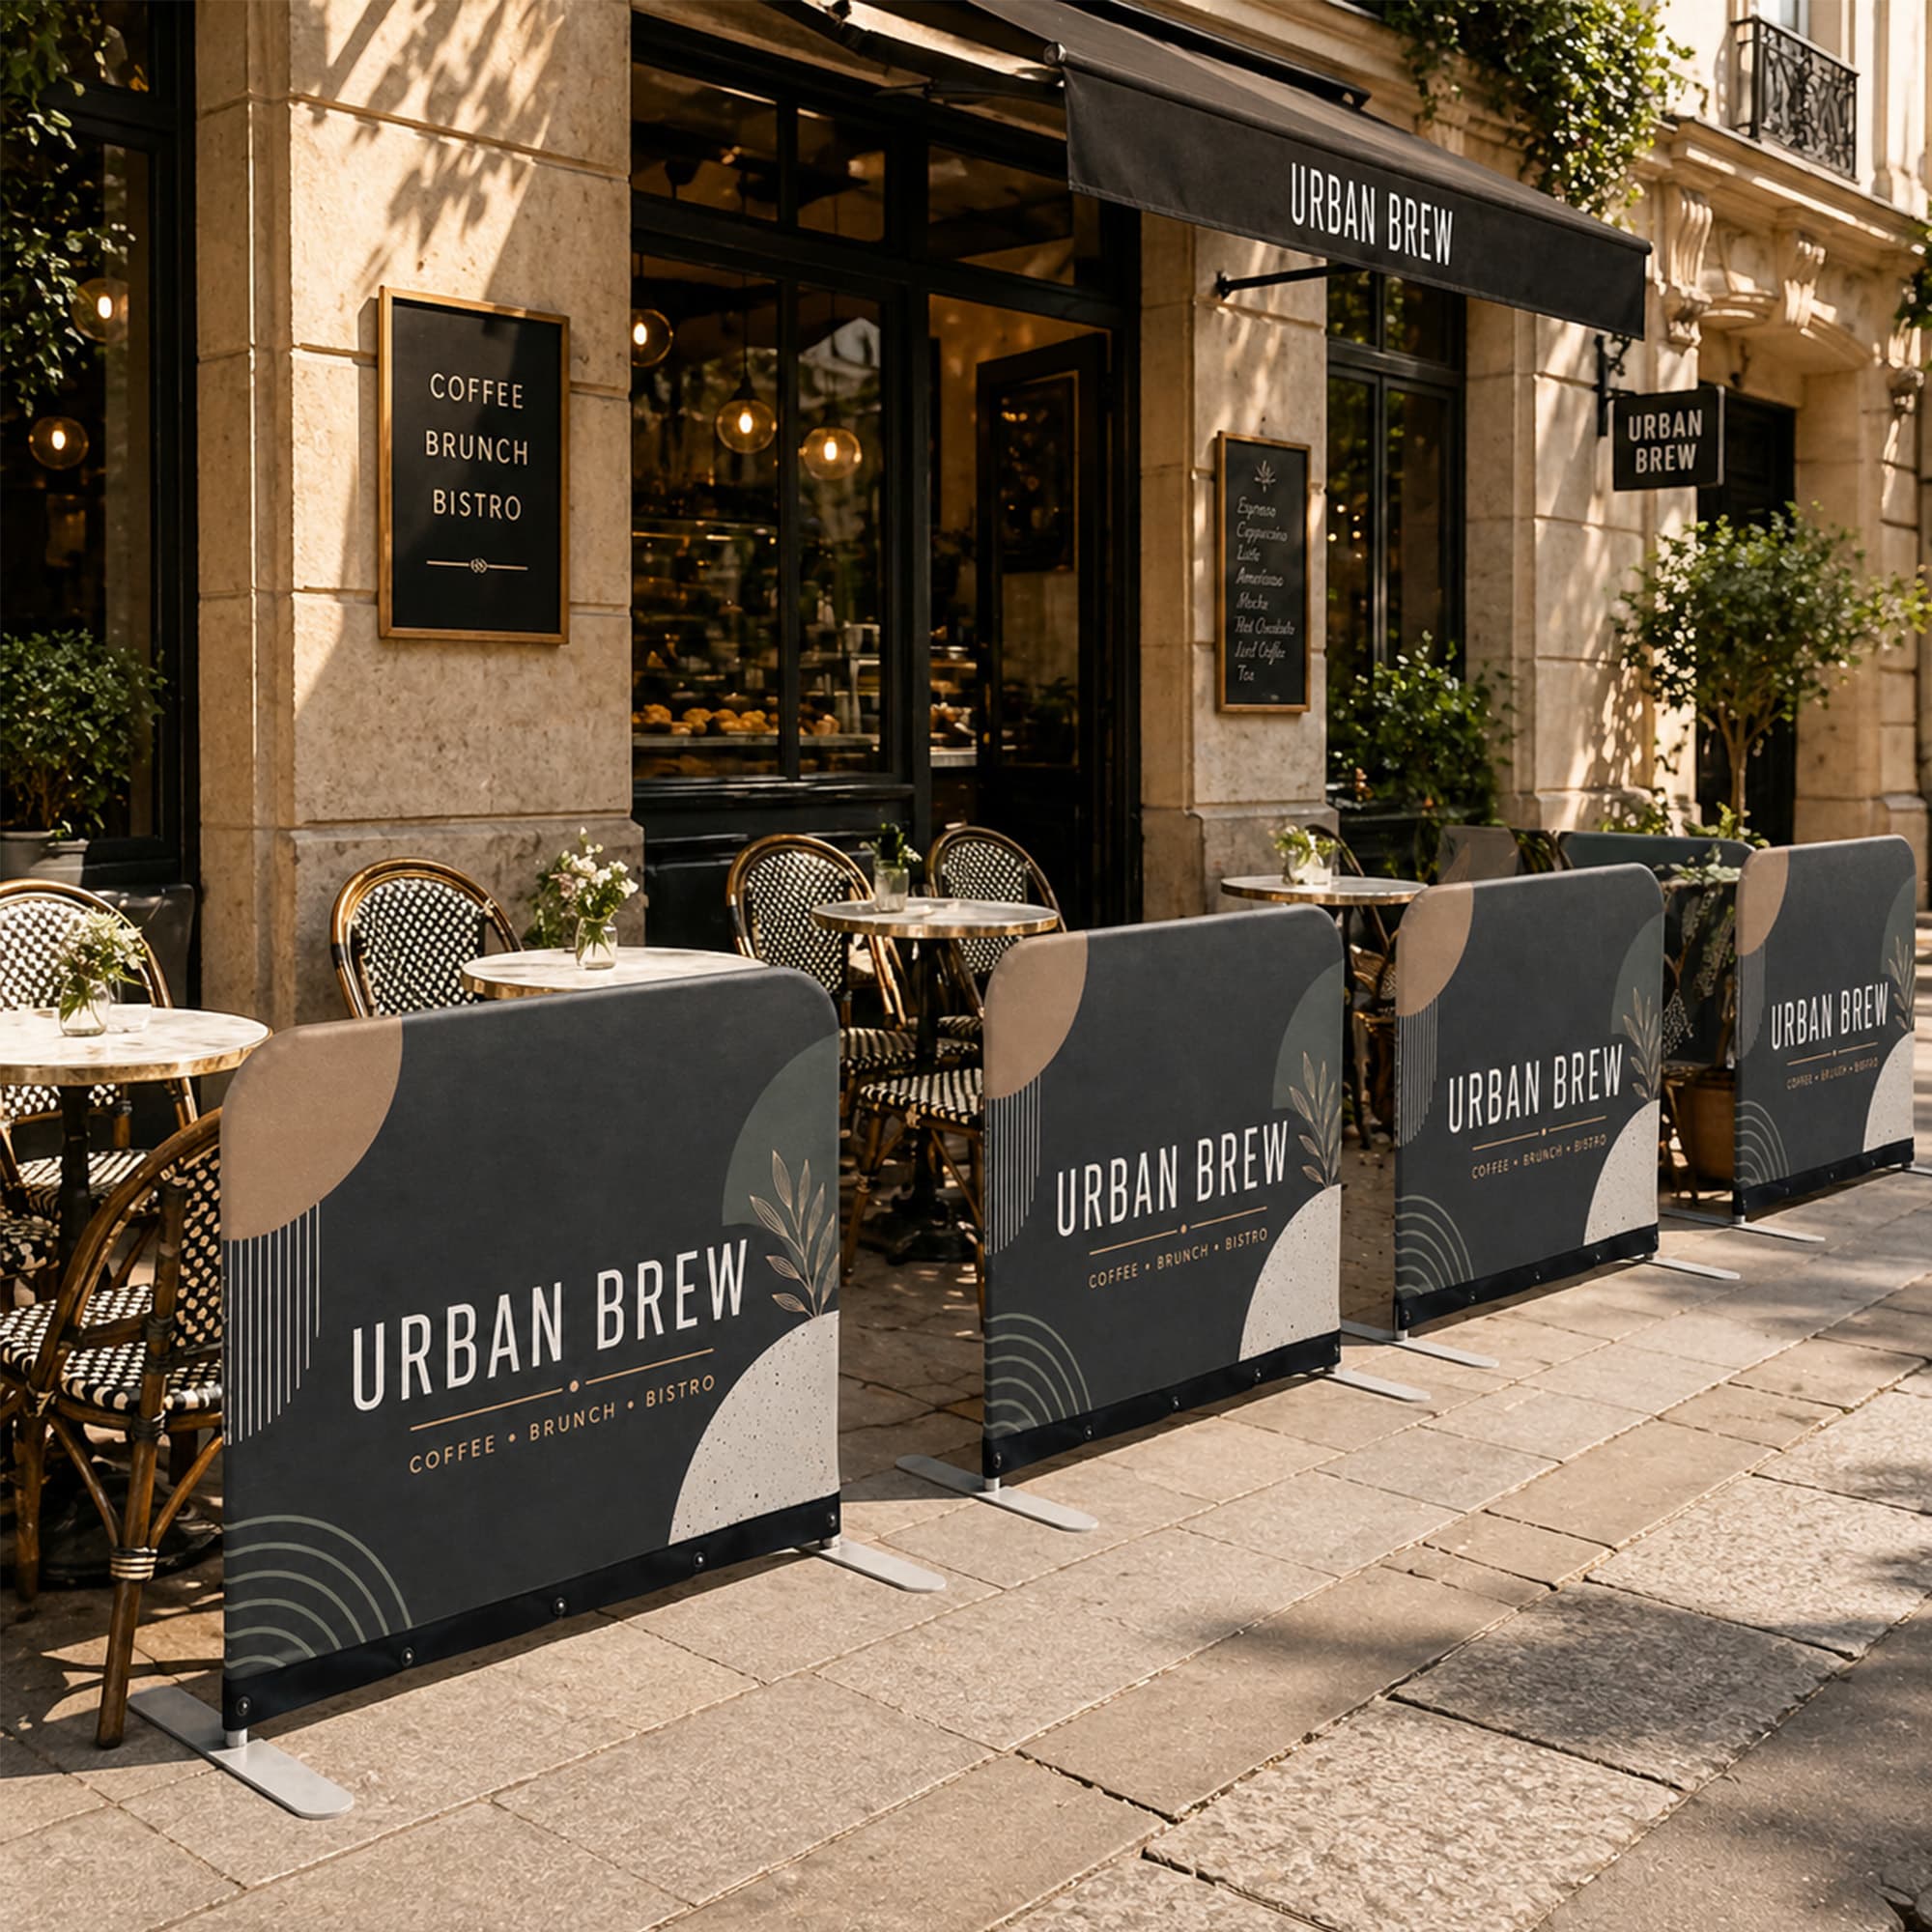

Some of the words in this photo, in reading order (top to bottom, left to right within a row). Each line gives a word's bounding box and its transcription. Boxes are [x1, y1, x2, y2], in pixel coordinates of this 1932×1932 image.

[1292, 162, 1376, 245] URBAN
[1388, 192, 1453, 266] BREW
[430, 373, 524, 410] COFFEE
[425, 430, 527, 466] BRUNCH
[1629, 409, 1702, 441] URBAN
[1635, 443, 1696, 474] BREW
[433, 489, 522, 522] BISTRO
[1772, 993, 1833, 1051] URBAN
[1840, 981, 1889, 1035] BREW
[1448, 1060, 1540, 1133] URBAN
[1553, 1043, 1623, 1110] BREW
[1057, 1145, 1178, 1236] URBAN
[1197, 1121, 1288, 1203] BREW
[1471, 1158, 1509, 1179] COFFEE
[1089, 1263, 1138, 1289] COFFEE
[1156, 1243, 1208, 1270] BRUNCH
[1225, 1228, 1268, 1251] BISTRO
[353, 1282, 562, 1412] URBAN
[597, 1239, 747, 1350] BREW
[409, 1435, 496, 1474] COFFEE
[529, 1403, 615, 1441] BRUNCH
[645, 1375, 716, 1407] BISTRO
